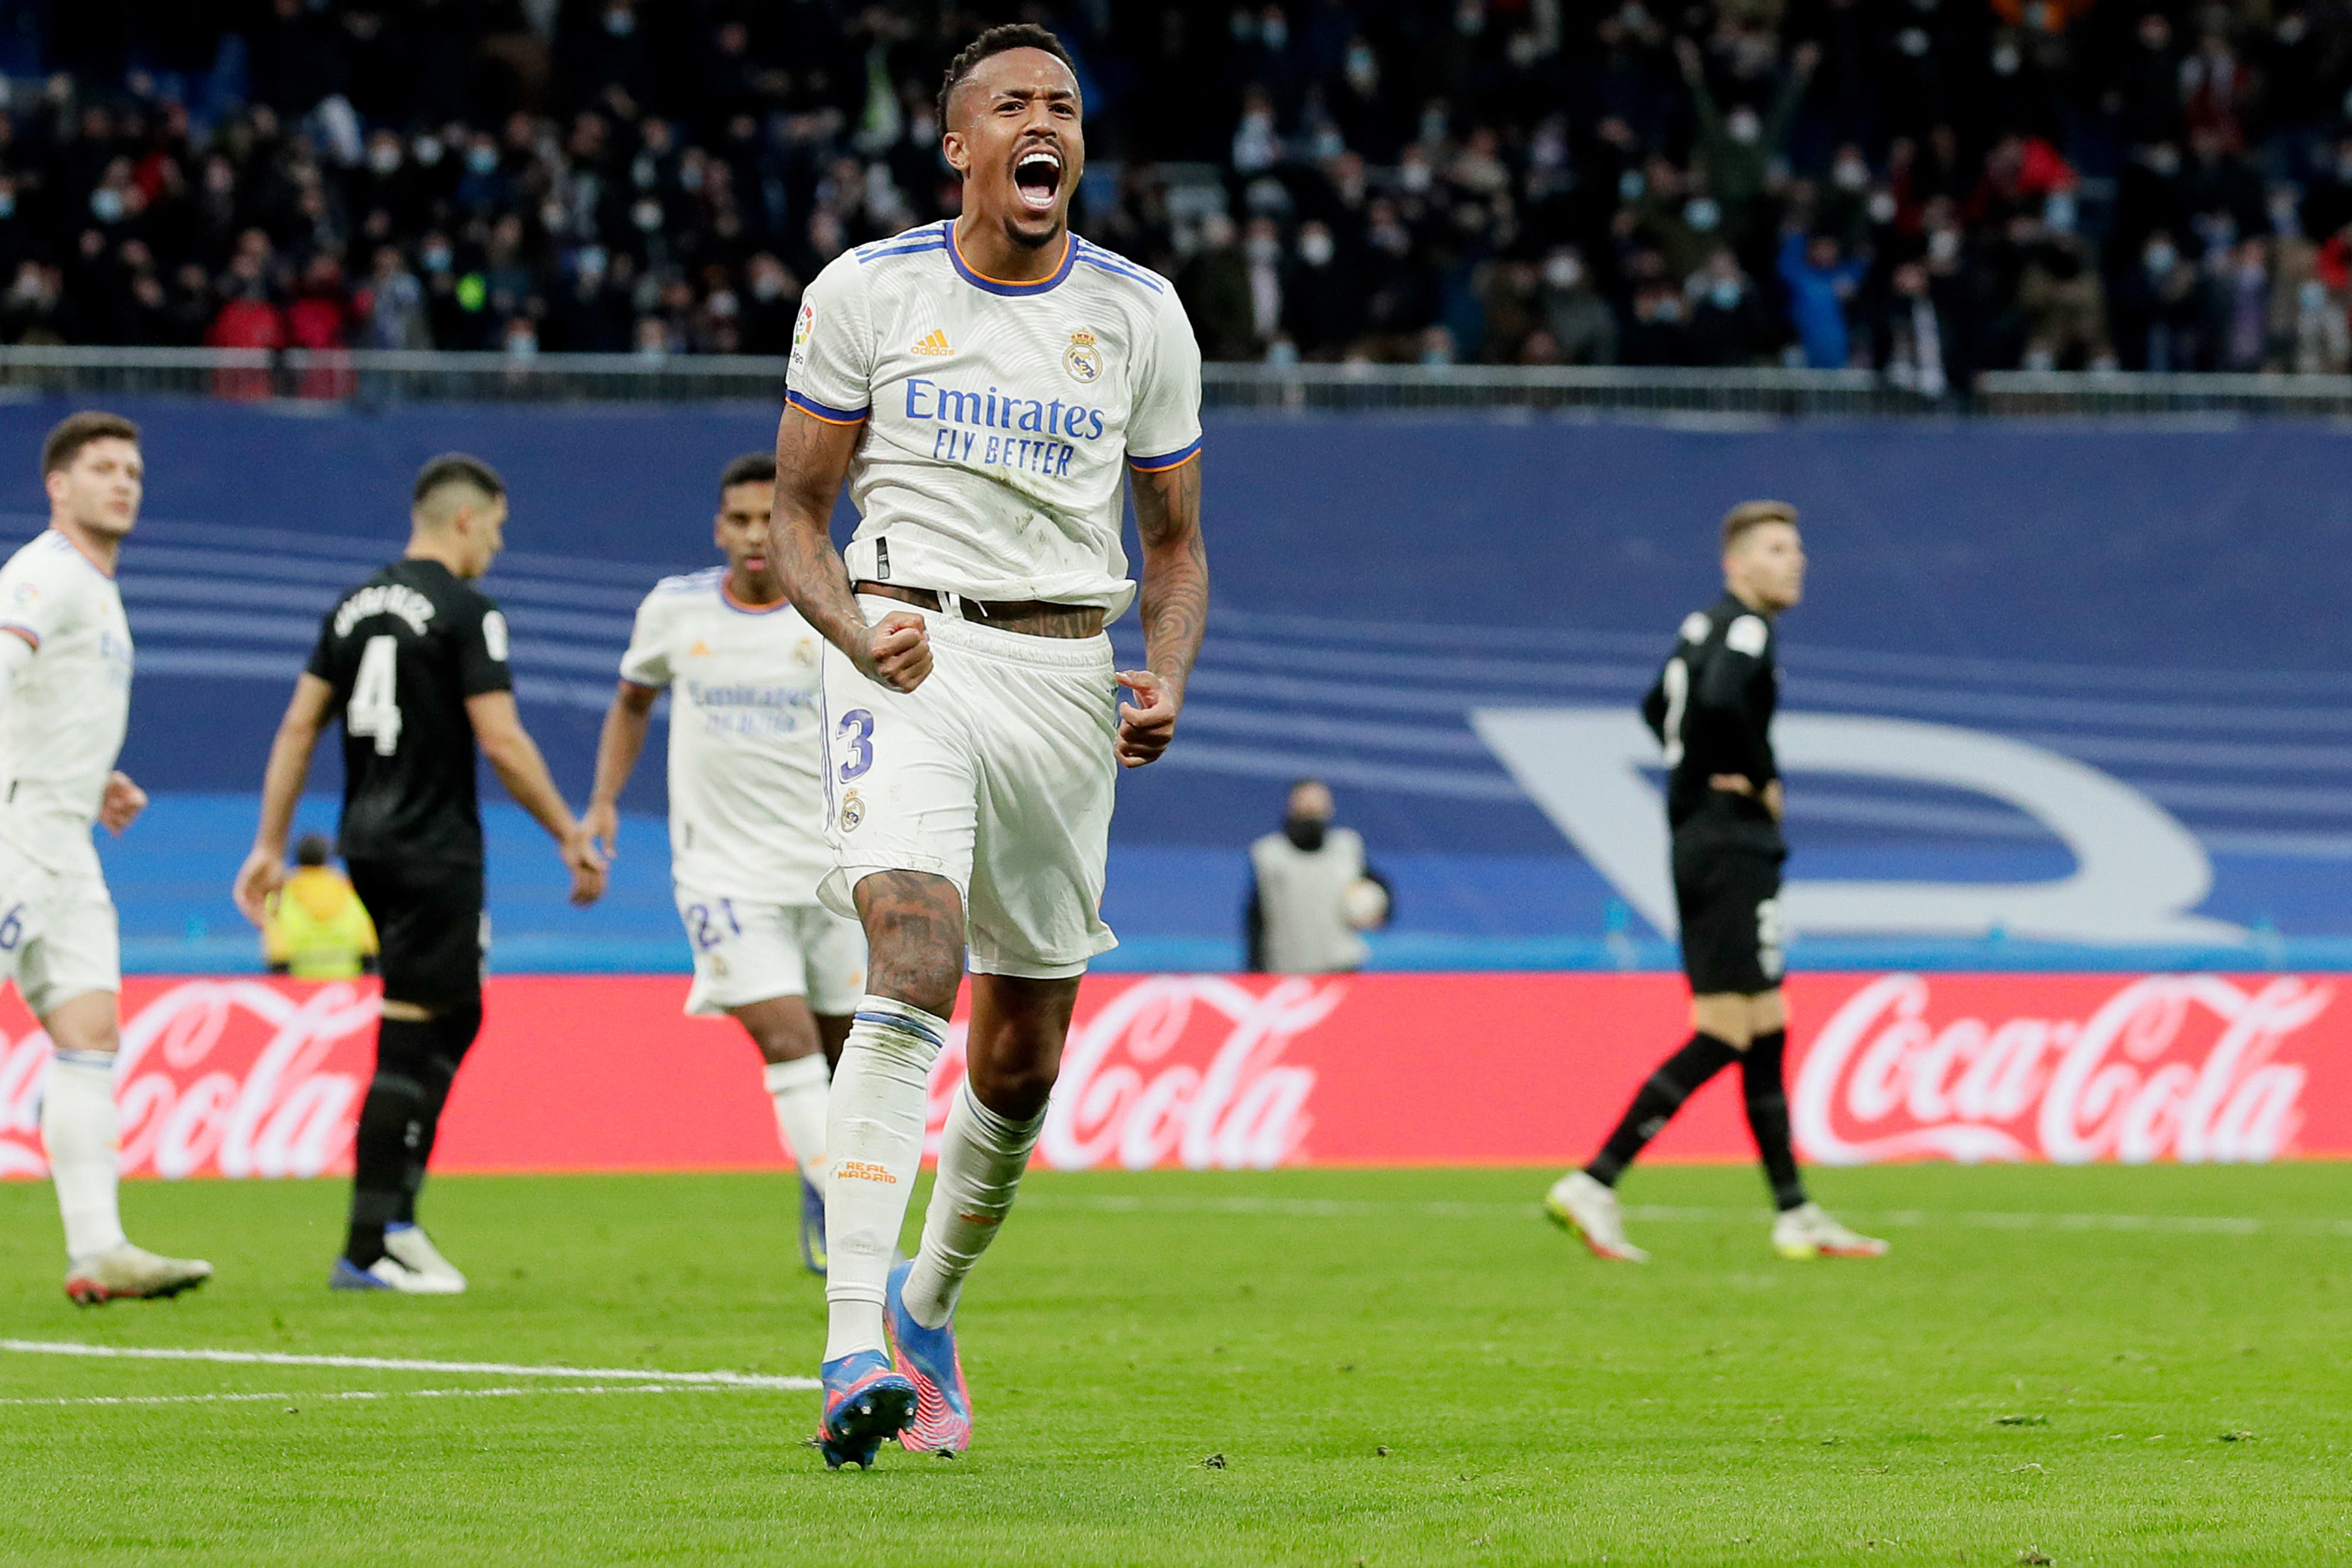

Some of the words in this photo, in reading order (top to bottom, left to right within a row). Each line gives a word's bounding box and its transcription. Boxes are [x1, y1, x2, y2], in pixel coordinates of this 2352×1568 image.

[911, 346, 956, 356] adidas
[906, 378, 1104, 440] Emirates
[933, 429, 976, 461] FLY
[984, 436, 1074, 476] BETTER
[347, 635, 402, 757] 4
[836, 708, 874, 784] 3
[687, 897, 741, 950] 21
[838, 1171, 897, 1184] MADRID
[846, 1161, 888, 1174] REAL
